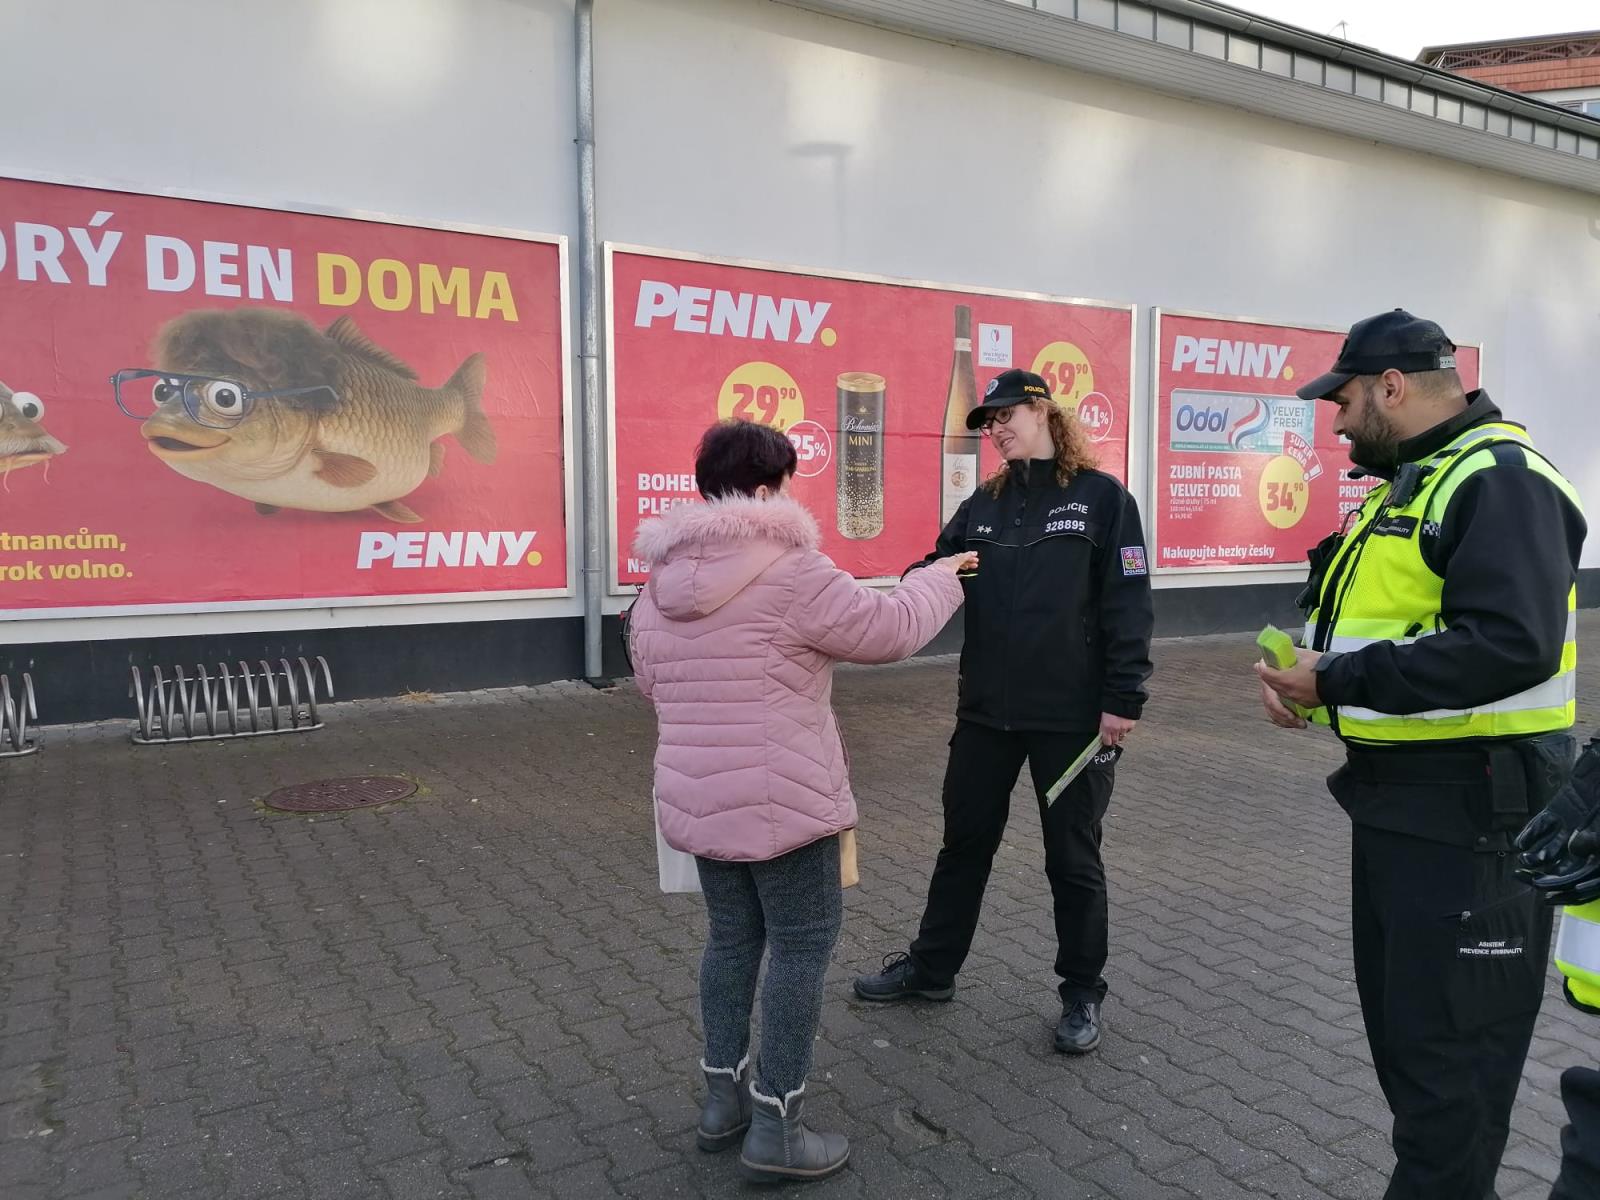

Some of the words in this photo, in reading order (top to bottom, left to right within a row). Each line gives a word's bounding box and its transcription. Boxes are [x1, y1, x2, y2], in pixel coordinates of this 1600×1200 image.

[0, 211, 123, 287] RÝ
[145, 234, 293, 302] DEN
[317, 252, 519, 322] DOMA
[1176, 404, 1229, 432] Odol
[1272, 406, 1306, 417] VELVET
[1273, 418, 1304, 428] FRESH
[848, 435, 873, 446] MINI
[1289, 434, 1313, 460] SUPER
[1287, 446, 1308, 468] CENA
[1170, 462, 1206, 480] ZUBNÍ
[1208, 465, 1242, 480] PASTA
[1170, 483, 1210, 497] VELVET
[1212, 484, 1242, 497] ODOL
[1048, 502, 1089, 517] POLICIE
[1045, 520, 1086, 532] 328895
[1163, 546, 1216, 560] Nakupujte
[1218, 545, 1248, 559] hezky
[1249, 543, 1275, 558] česky
[48, 559, 133, 580] volno.
